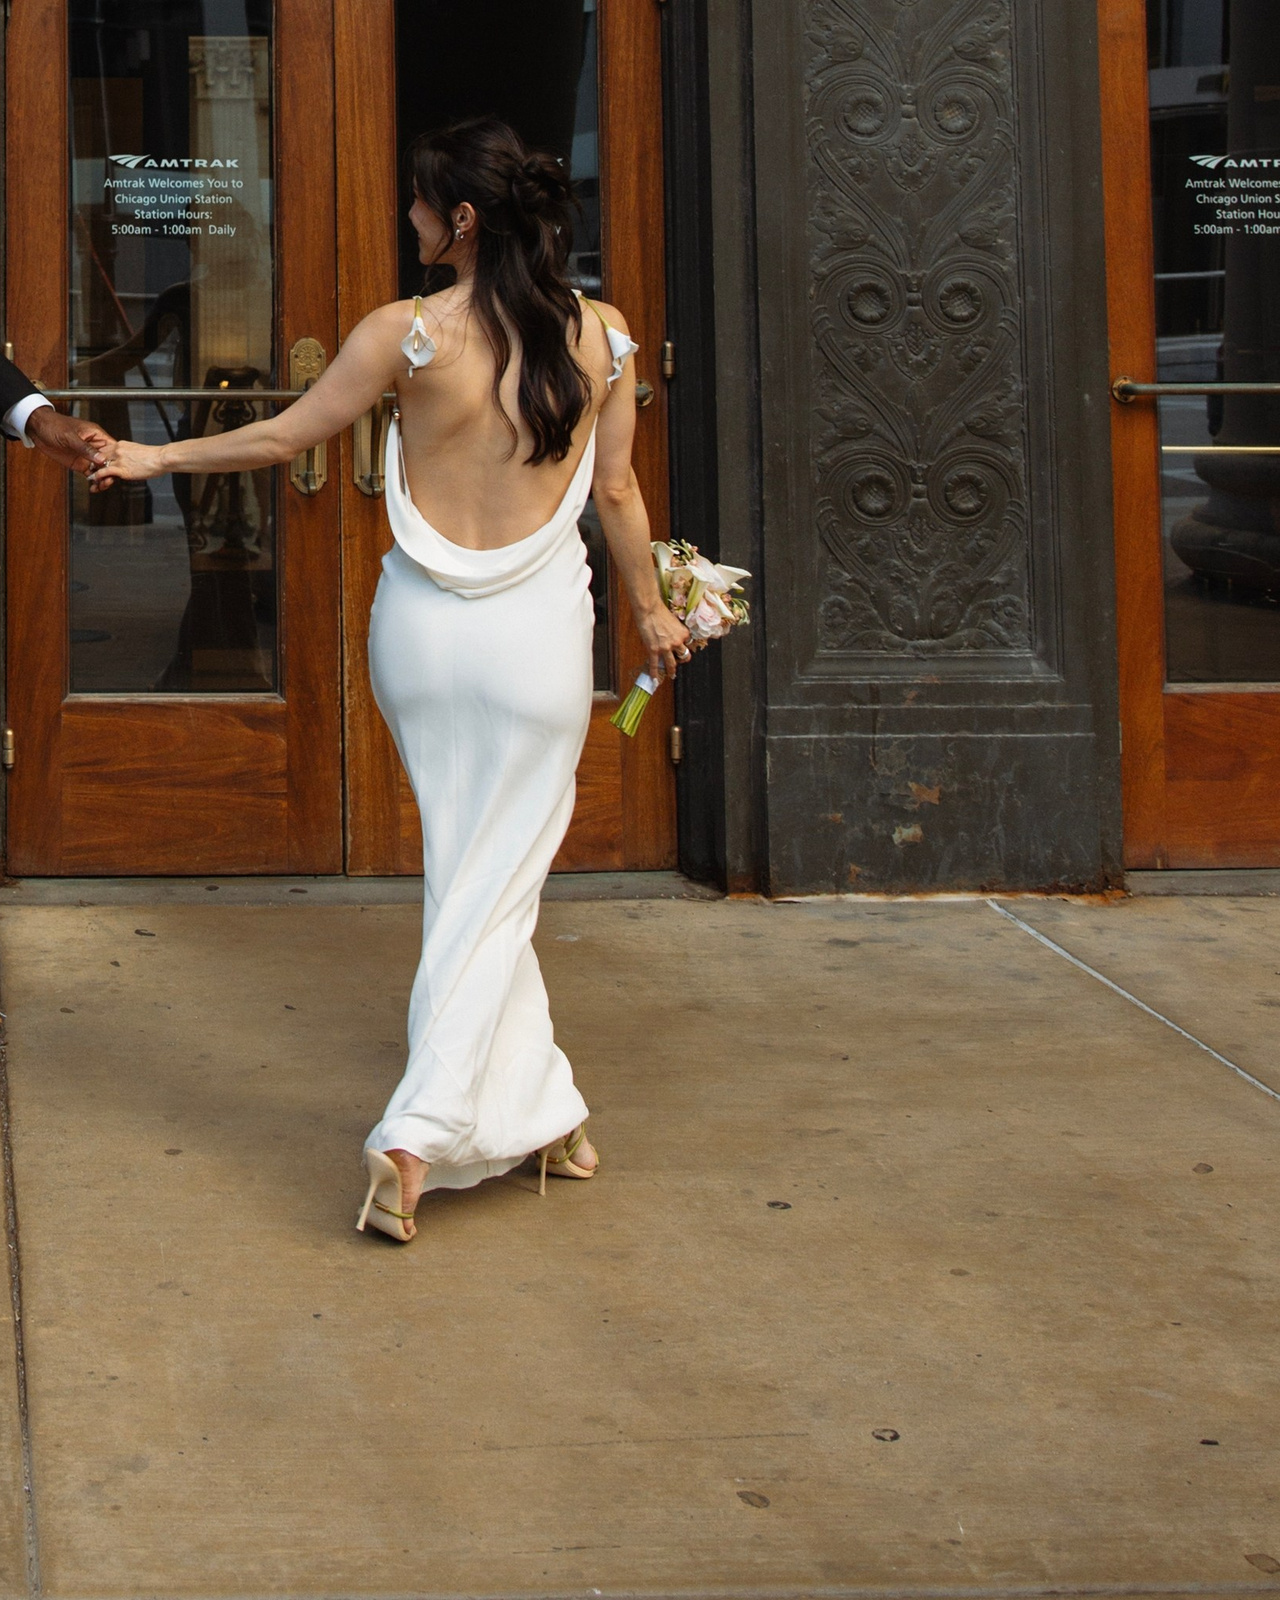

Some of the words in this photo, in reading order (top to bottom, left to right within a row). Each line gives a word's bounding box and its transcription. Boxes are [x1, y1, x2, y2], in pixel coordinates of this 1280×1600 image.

[144, 158, 239, 168] AMTRAK
[103, 177, 146, 189] Amtrak
[148, 177, 205, 189] Welcomes
[207, 177, 229, 189] You
[231, 178, 244, 189] to
[1184, 177, 1226, 189] Amtrak
[114, 193, 157, 207] Chicago
[159, 193, 192, 205] Union
[194, 193, 233, 205] Station
[1195, 193, 1238, 206] Chicago
[1240, 193, 1272, 204] Union
[134, 208, 174, 220] Station
[177, 209, 213, 220] Hours:
[1215, 208, 1255, 220] Station
[111, 224, 152, 236] 5:00am
[162, 224, 202, 236] 1:00am
[208, 224, 237, 238] Daily
[1193, 224, 1234, 235] 5:00am
